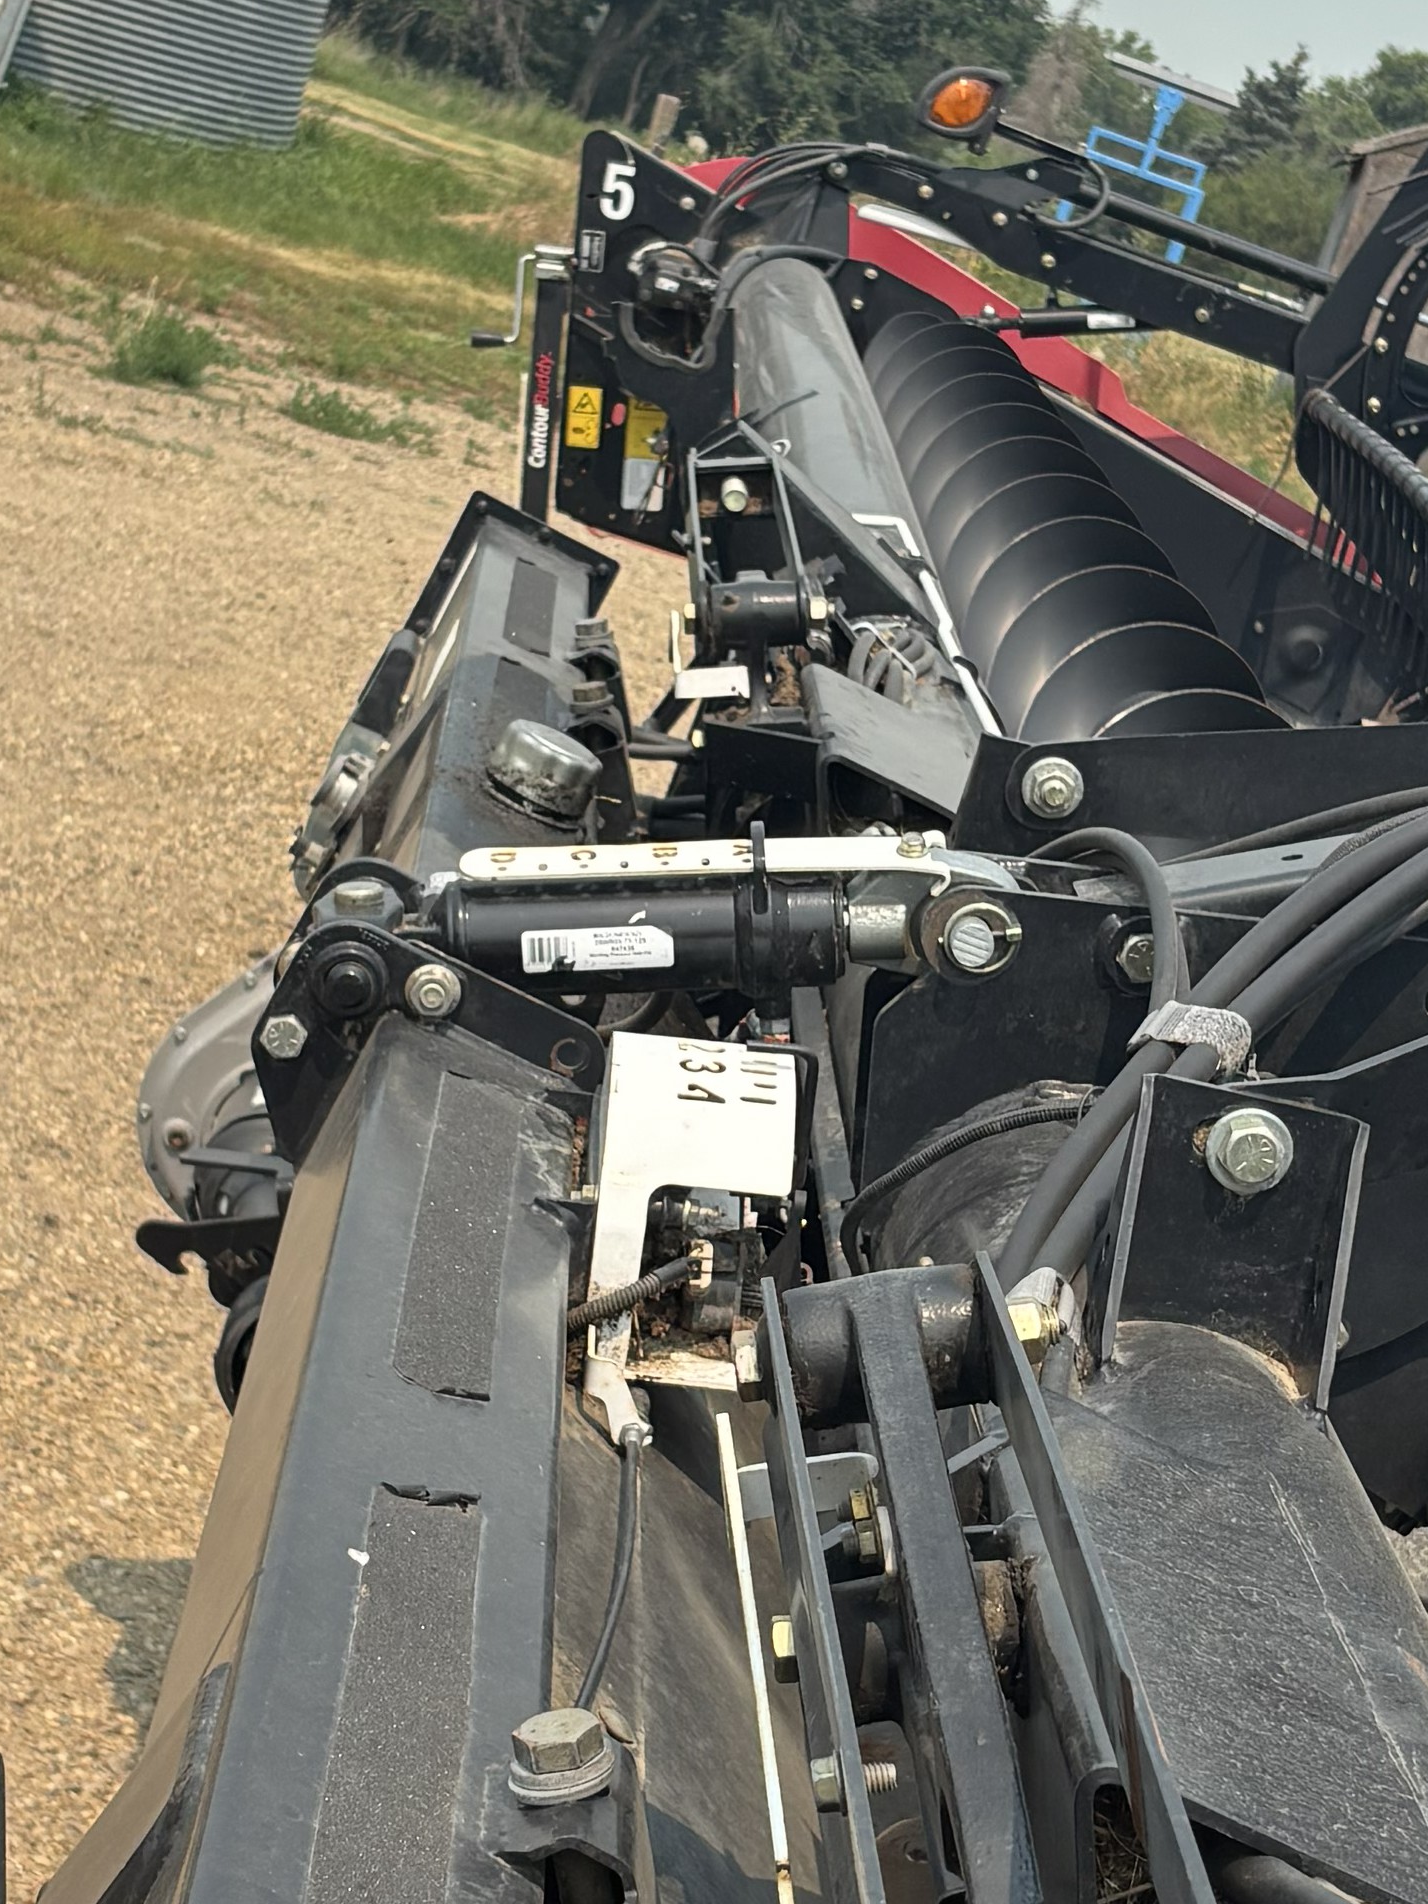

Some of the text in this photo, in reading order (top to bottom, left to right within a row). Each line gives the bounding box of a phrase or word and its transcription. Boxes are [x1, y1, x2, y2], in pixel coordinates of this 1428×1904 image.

[599, 162, 636, 221] 5
[678, 1058, 727, 1074] 3
[676, 1082, 727, 1105] 4
